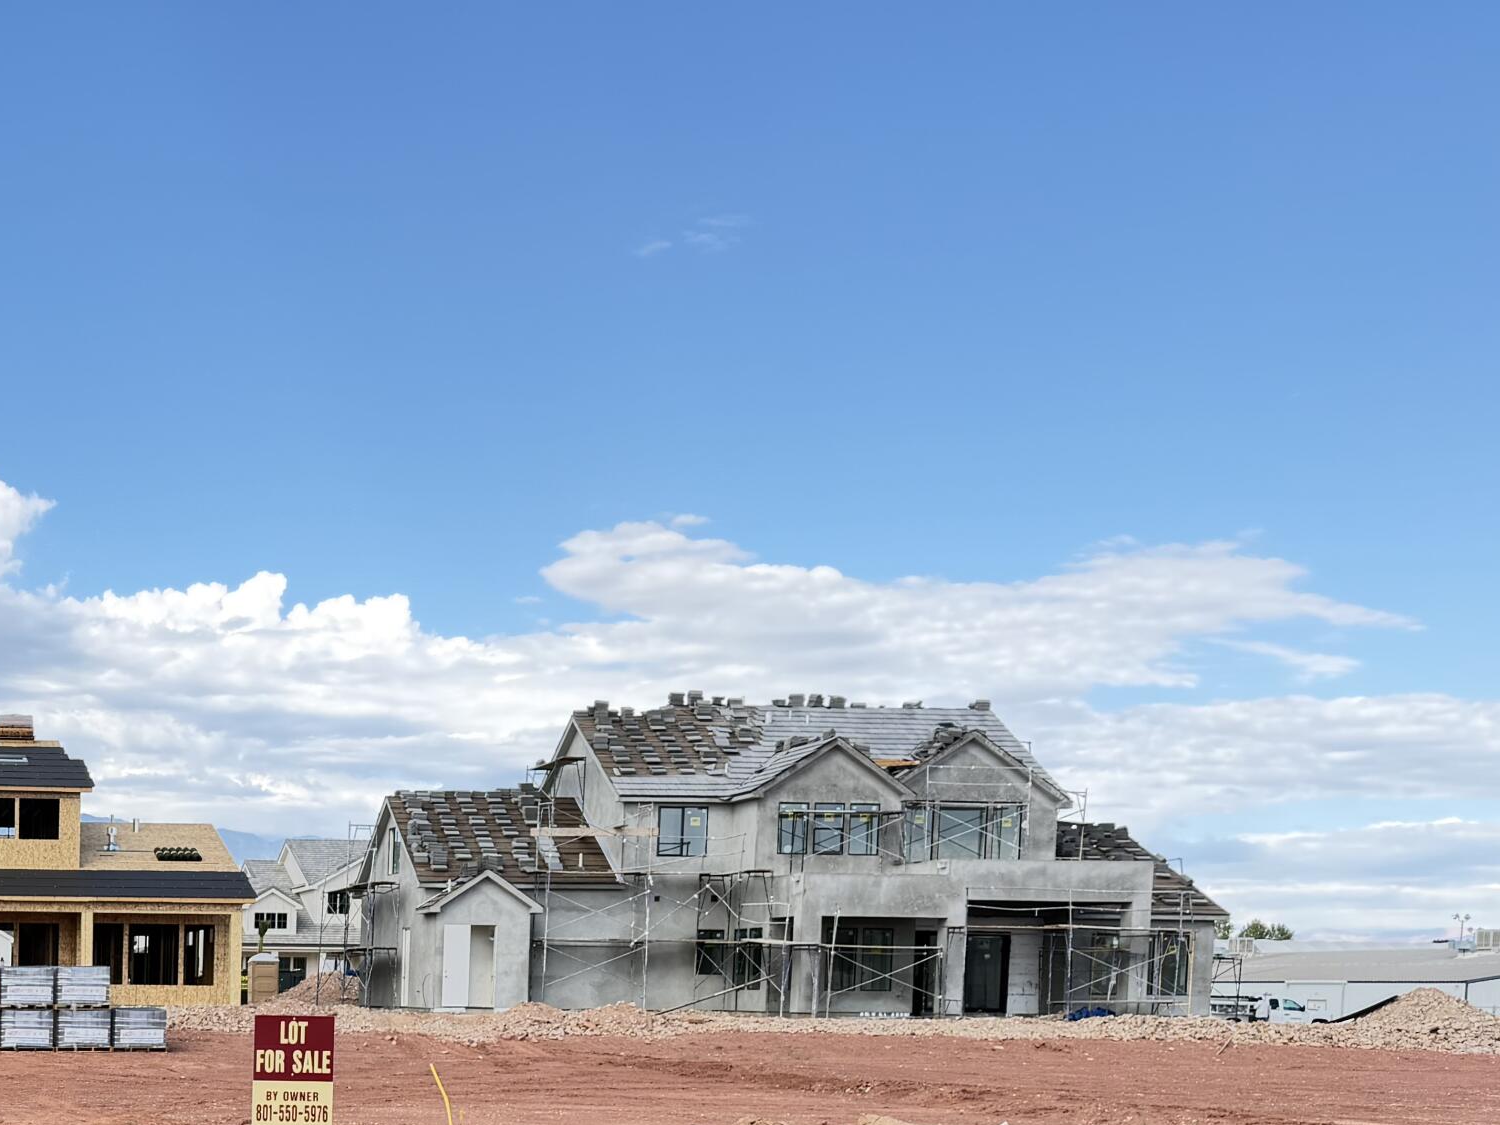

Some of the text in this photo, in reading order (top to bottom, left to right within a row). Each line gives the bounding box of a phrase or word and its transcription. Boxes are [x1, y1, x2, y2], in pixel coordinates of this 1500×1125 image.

[280, 1021, 308, 1044] LOT
[256, 1049, 331, 1074] FOR SALE
[266, 1091, 318, 1101] BY OWNER
[256, 1104, 328, 1122] 801-550-5976
